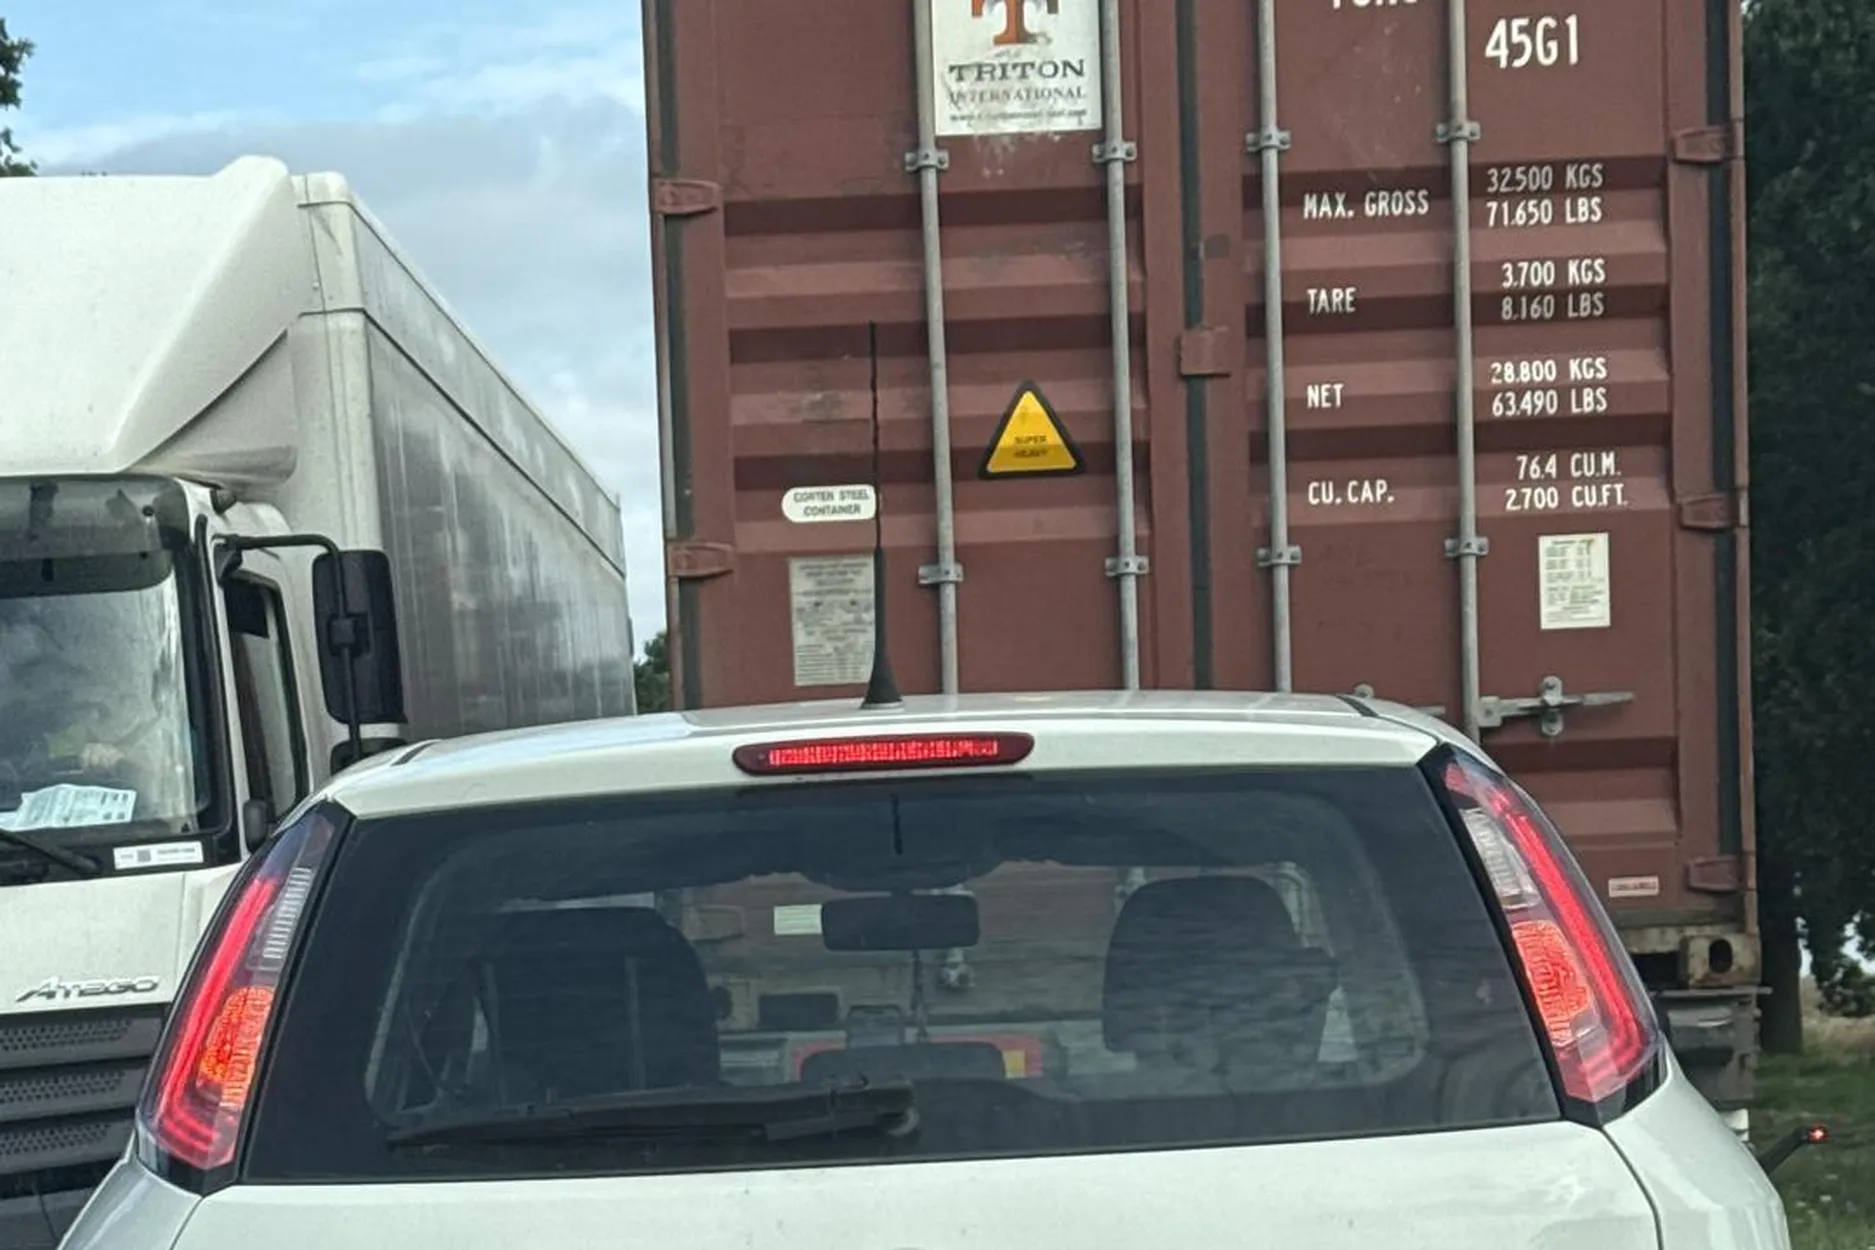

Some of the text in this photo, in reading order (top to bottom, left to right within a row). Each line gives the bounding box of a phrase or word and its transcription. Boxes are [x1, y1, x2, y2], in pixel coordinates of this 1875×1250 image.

[1485, 14, 1579, 68] 45G1
[948, 58, 1085, 82] TRITON
[1565, 162, 1603, 189] KGS
[1303, 189, 1429, 219] MAX. GROSS
[1486, 196, 1602, 228] 71.650 LBS
[1502, 258, 1606, 288] 3.700 KGS
[1306, 287, 1357, 314] TARE
[1502, 292, 1604, 320] 8.160 LBS
[1490, 357, 1607, 384] 28.800 KGS
[1306, 384, 1343, 409] NET
[1491, 387, 1607, 417] 63.490 LBS
[1516, 453, 1557, 481] 76.4
